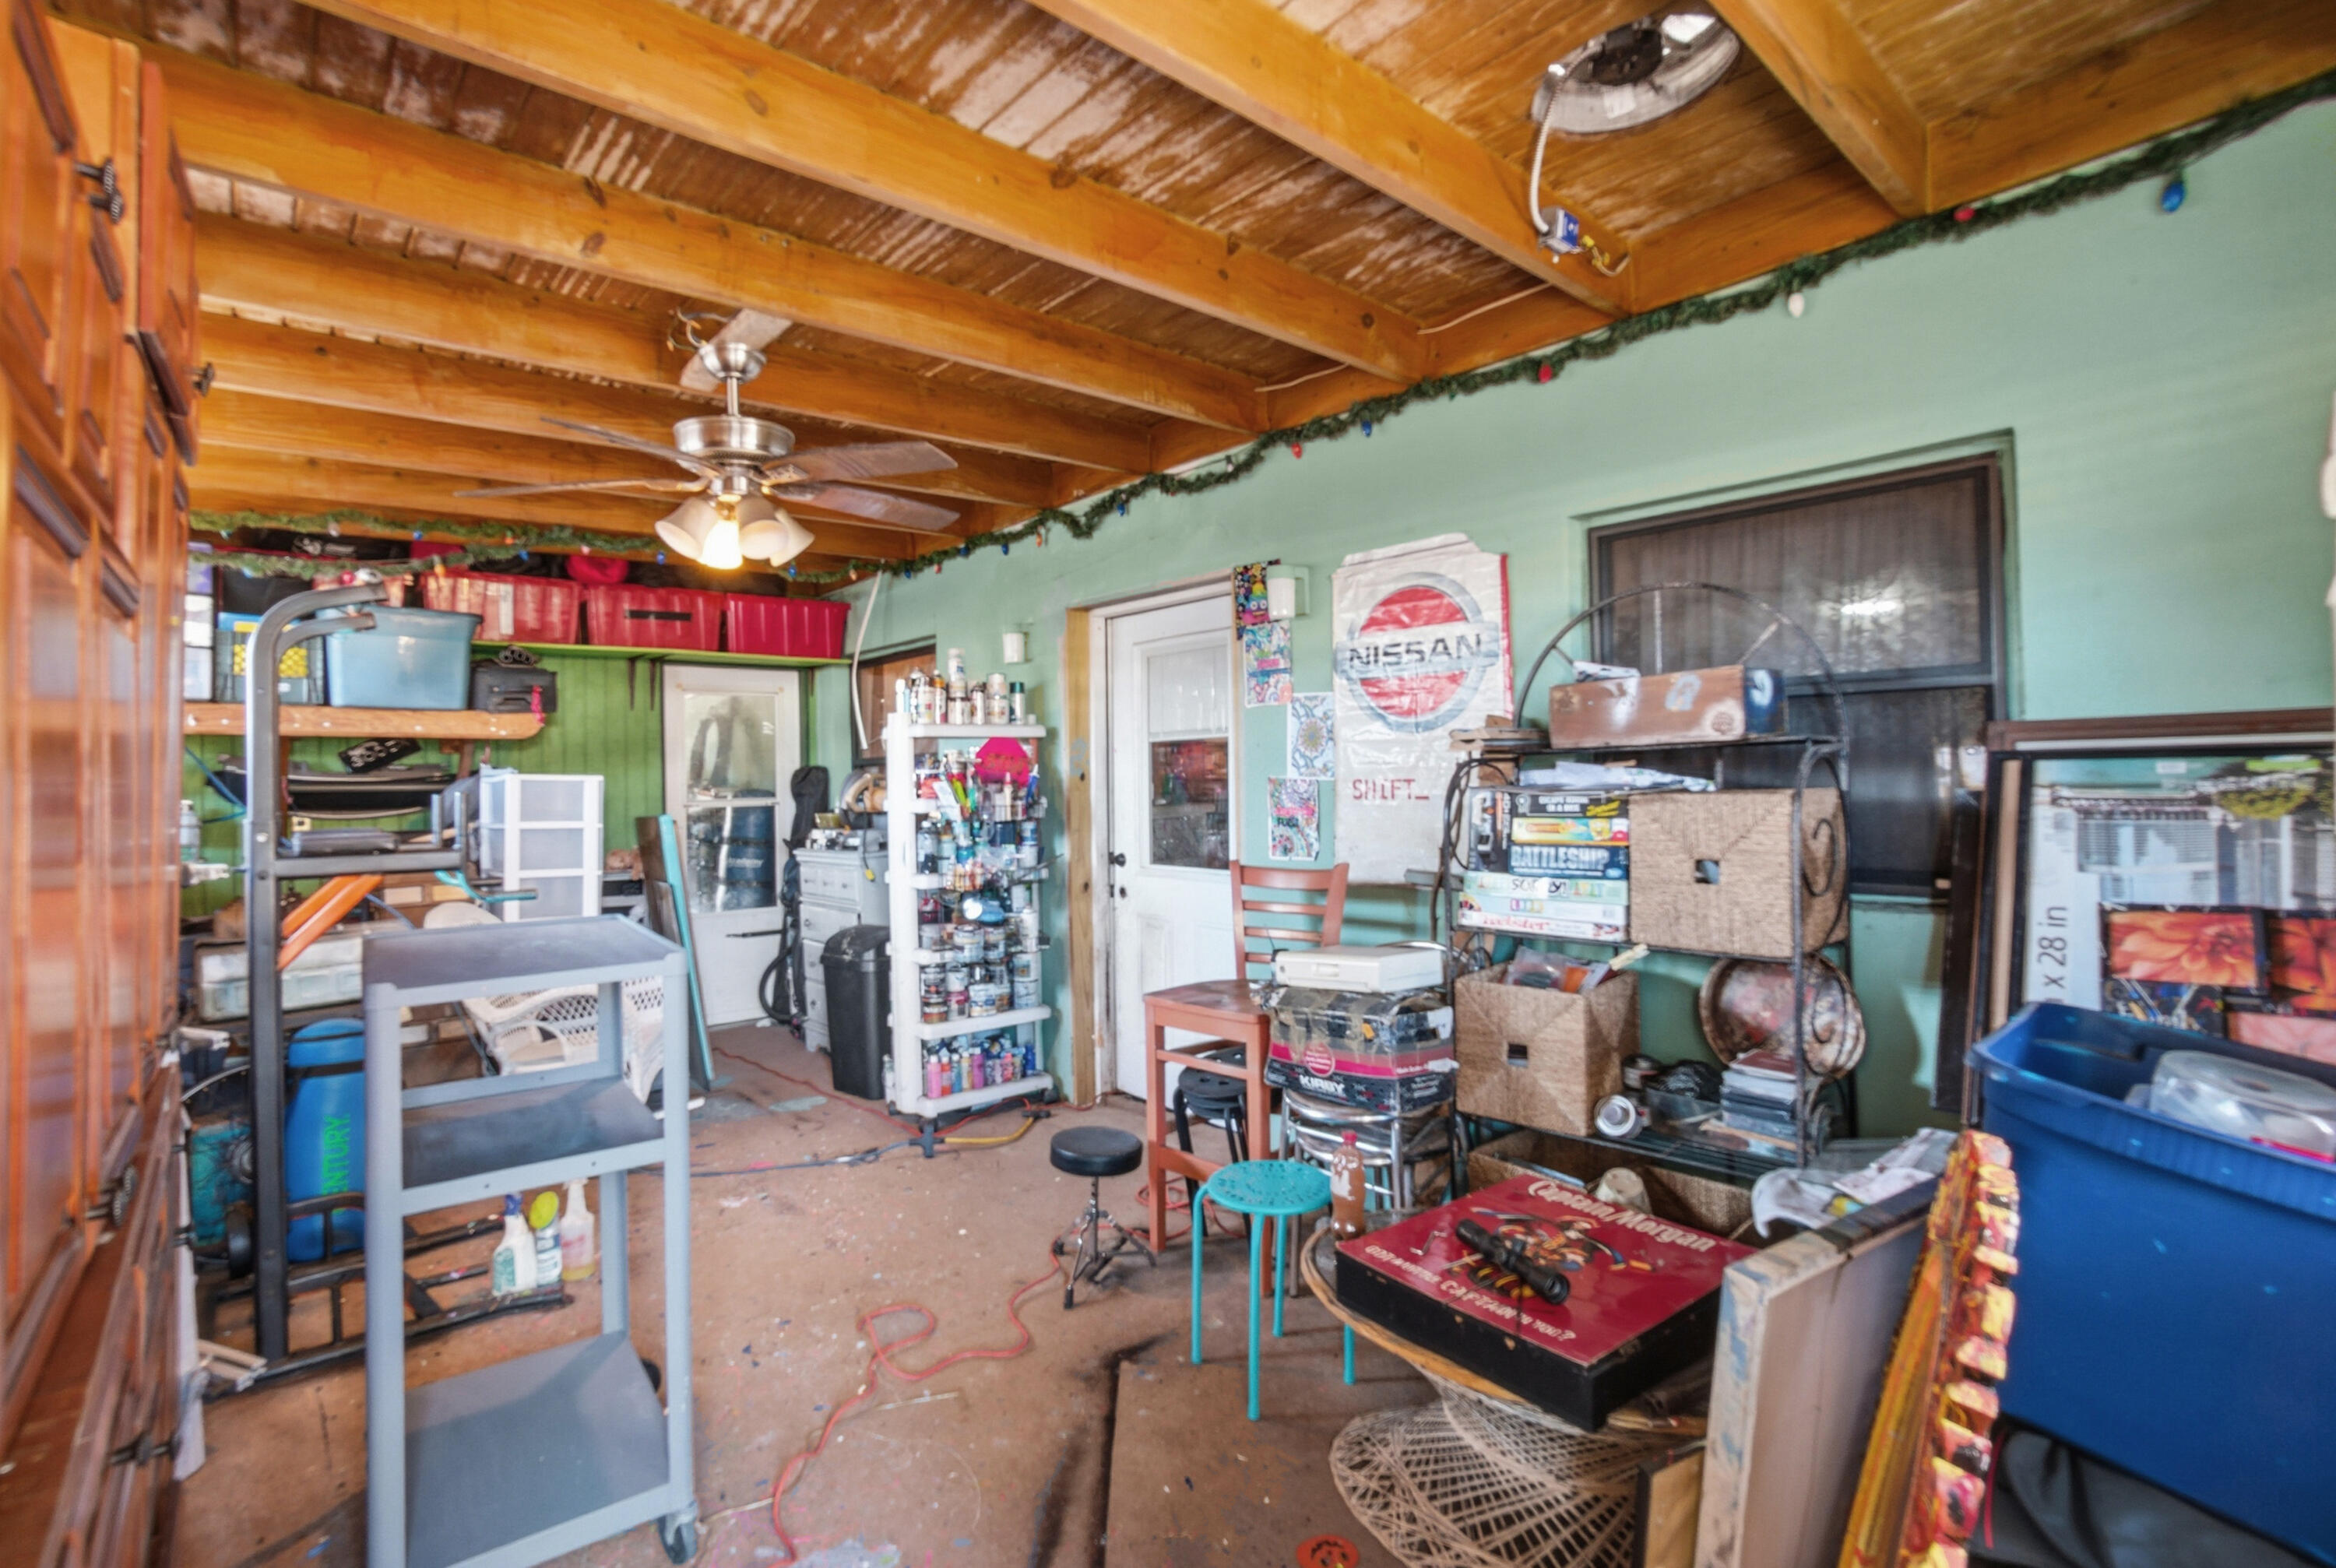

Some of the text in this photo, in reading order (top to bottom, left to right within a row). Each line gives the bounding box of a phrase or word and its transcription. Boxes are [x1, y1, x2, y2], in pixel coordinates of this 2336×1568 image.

[1349, 634, 1480, 669] NISSAN
[1511, 845, 1610, 870] BATTLESHIP
[2037, 906, 2067, 927] in
[2037, 937, 2067, 966] 28
[1529, 1180, 1715, 1252] Captain Morgan
